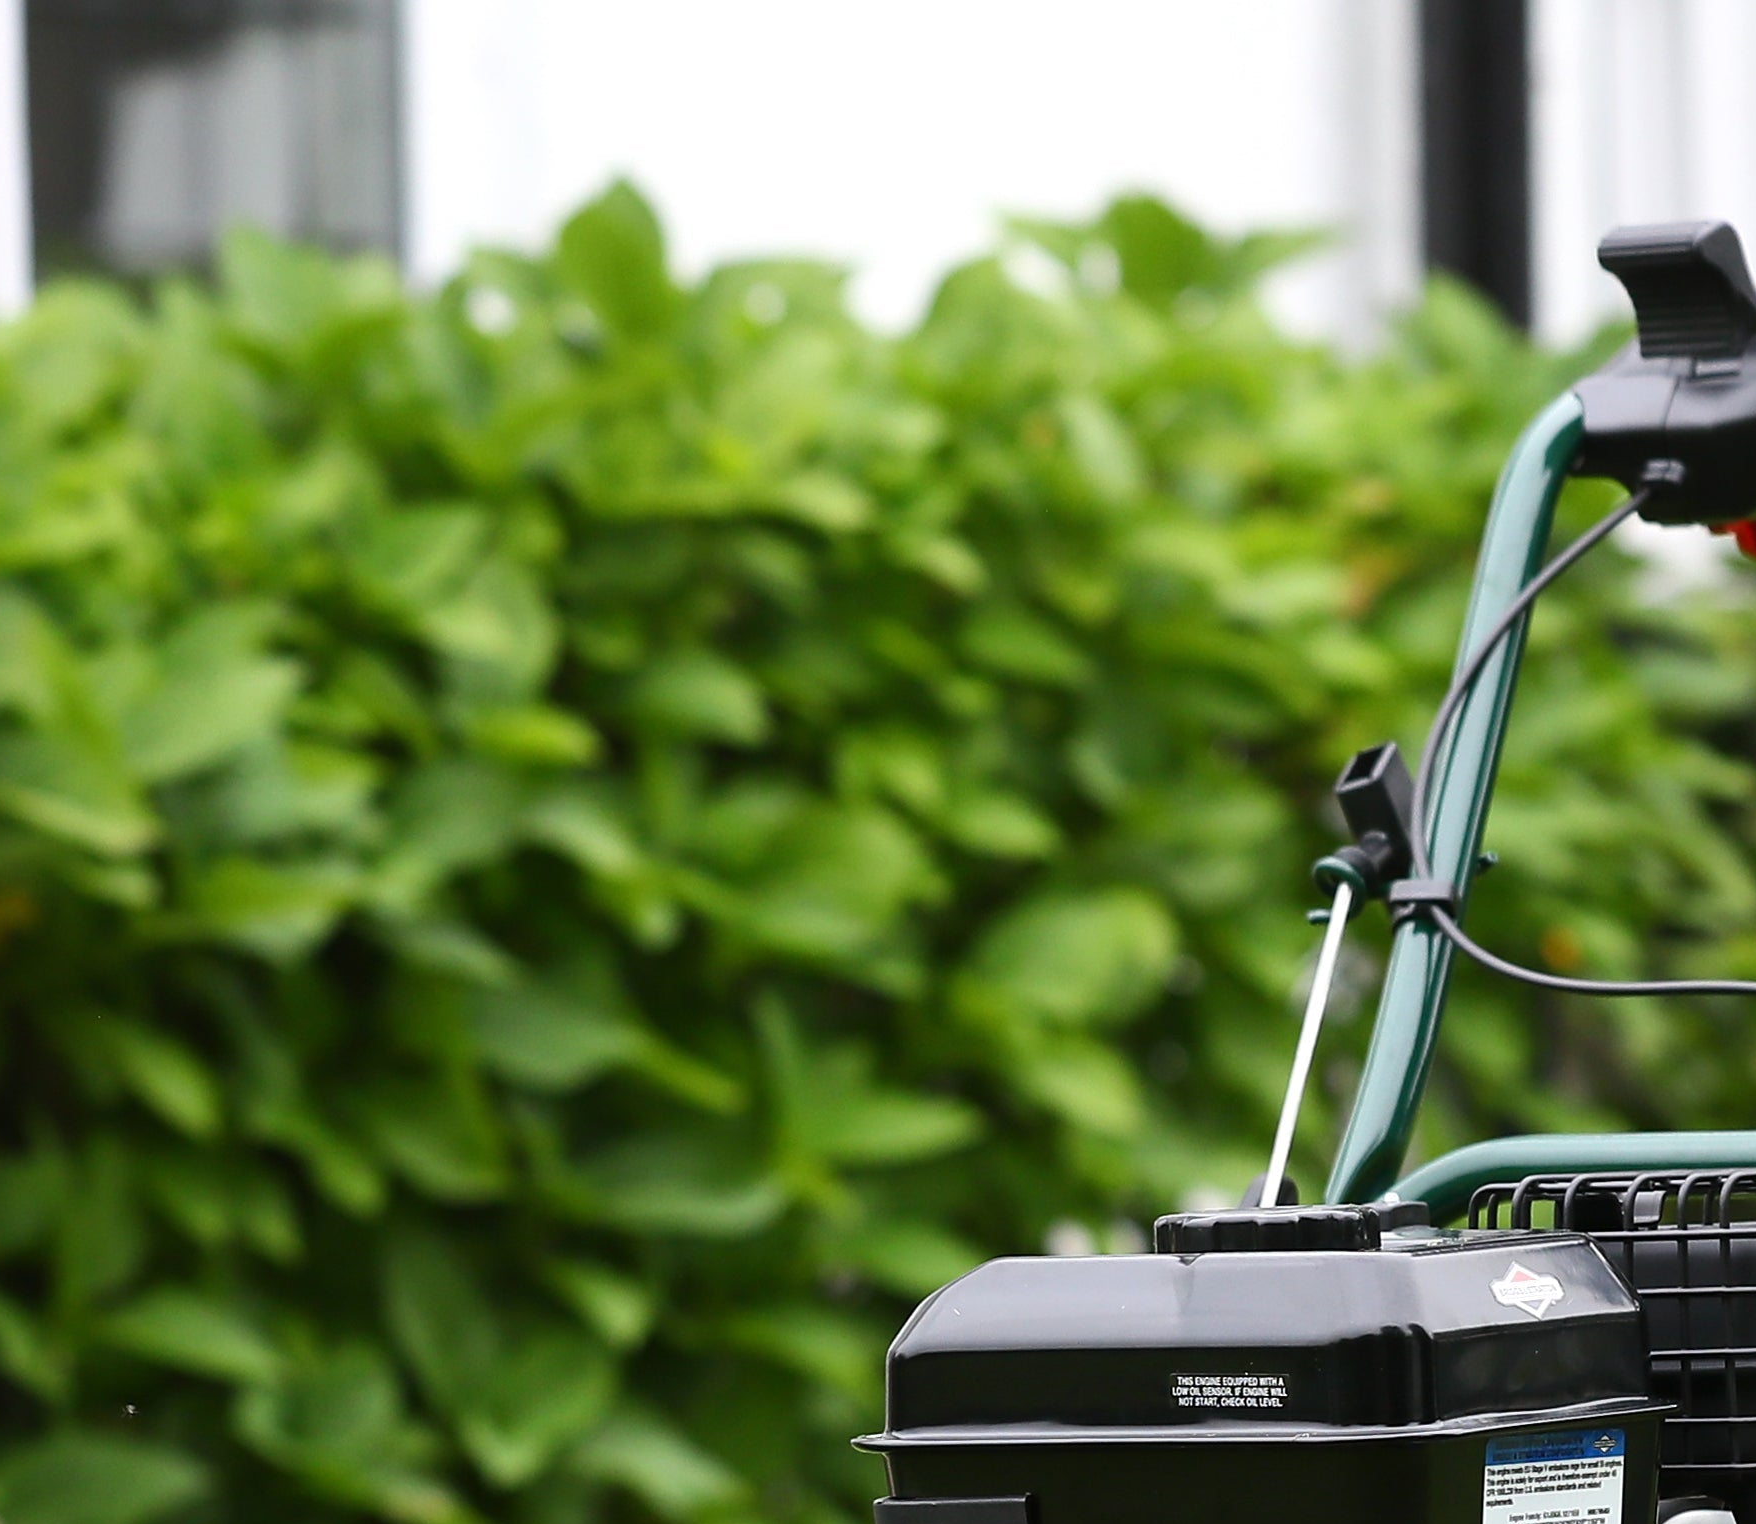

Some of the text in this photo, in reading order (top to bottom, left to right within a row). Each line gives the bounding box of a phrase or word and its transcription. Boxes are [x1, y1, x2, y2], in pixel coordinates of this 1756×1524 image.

[1177, 1377, 1285, 1386] THIS ENGINE EQUIPPED WITH A
[1172, 1387, 1189, 1396] LOW
[1190, 1387, 1201, 1396] OIL
[1234, 1387, 1241, 1396] IF
[1243, 1387, 1269, 1396] ENGINE
[1270, 1387, 1287, 1396] WILL
[1178, 1397, 1193, 1407] NOT
[1194, 1397, 1220, 1408] START,
[1221, 1397, 1245, 1407] CHECK
[1246, 1397, 1258, 1407] OIL
